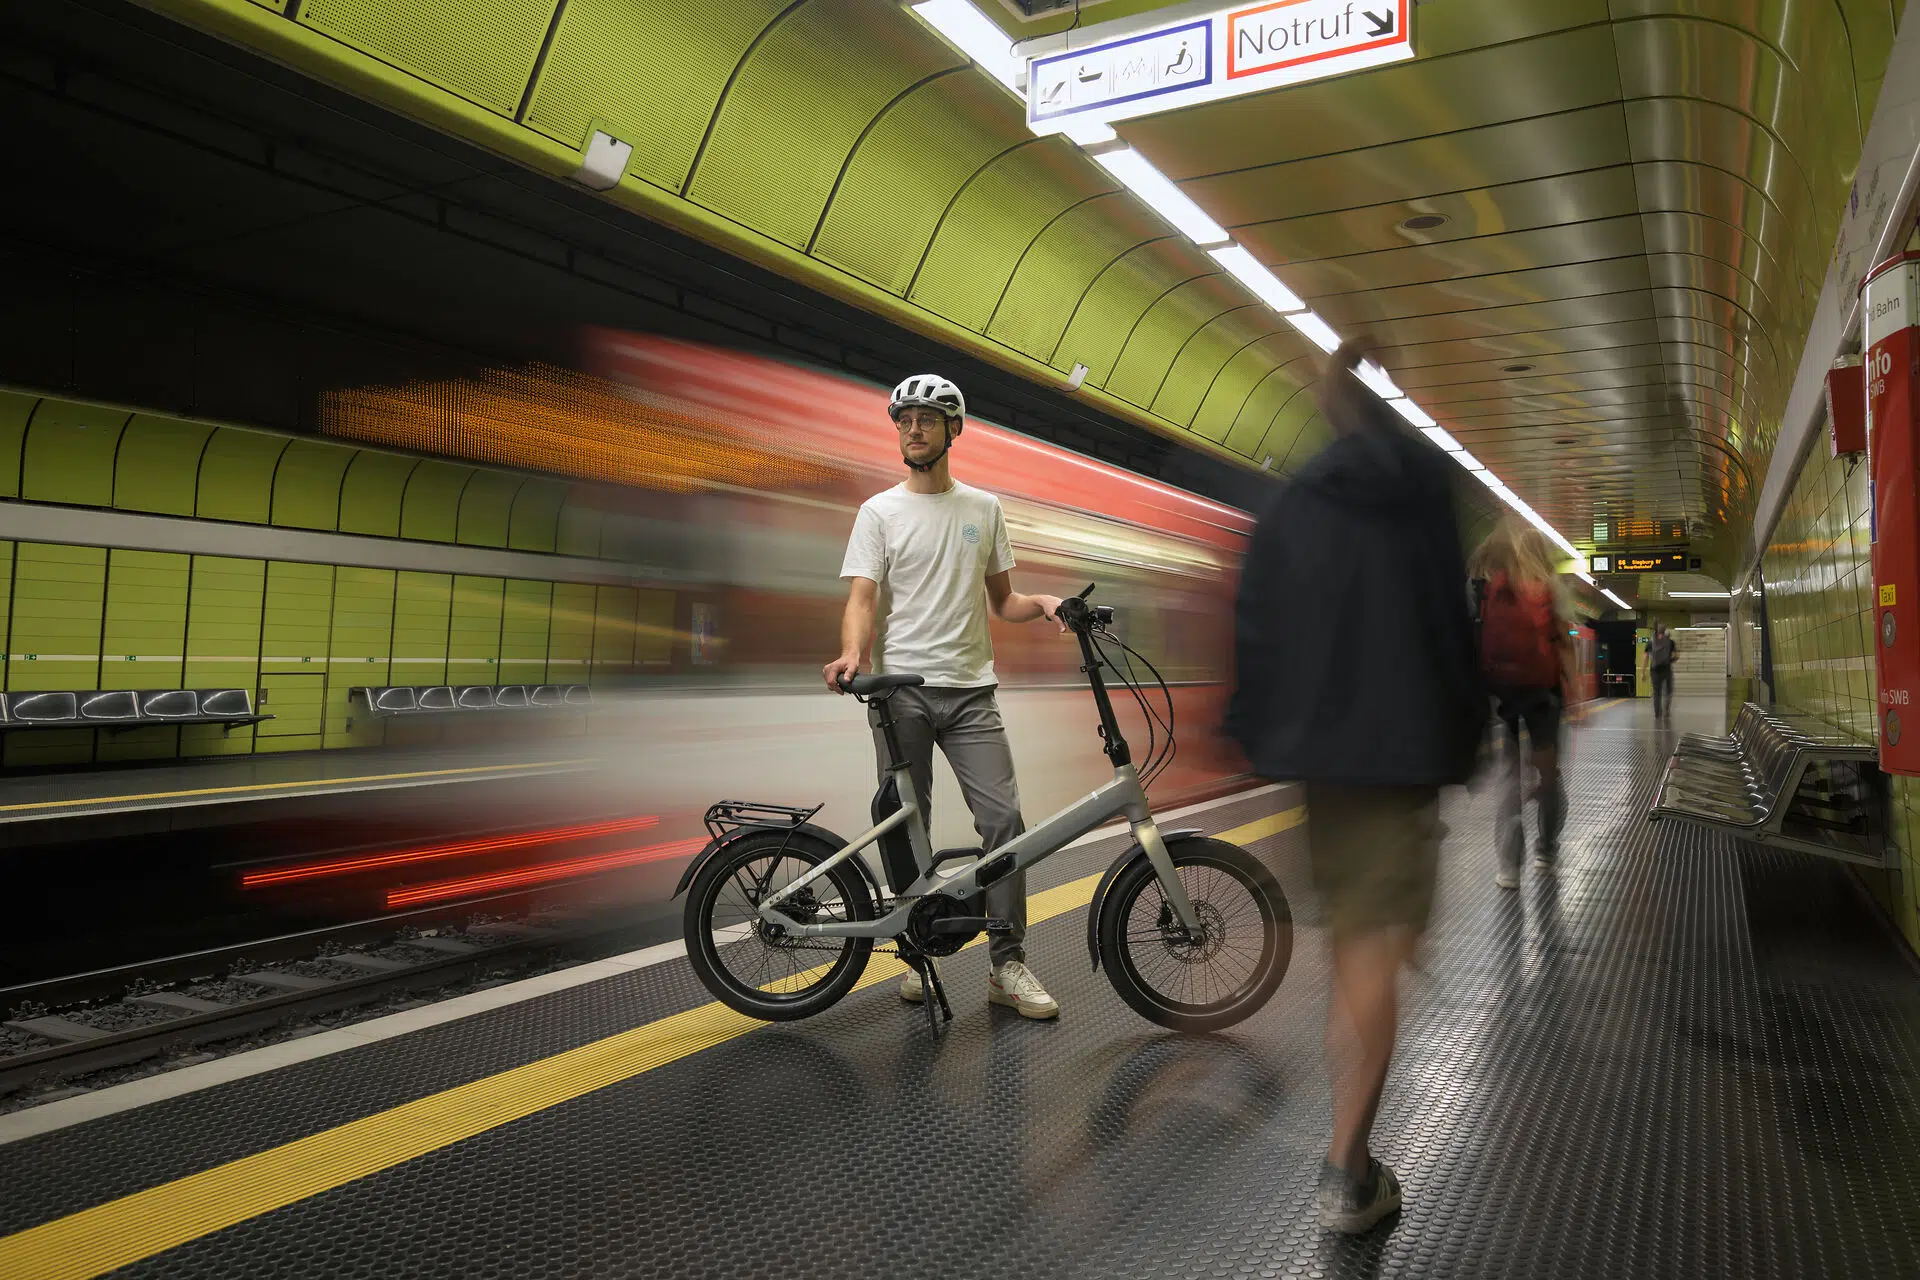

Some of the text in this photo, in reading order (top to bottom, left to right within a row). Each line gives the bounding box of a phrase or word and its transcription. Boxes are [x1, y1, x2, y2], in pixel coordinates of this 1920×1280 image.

[1238, 3, 1354, 59] Notruf
[1876, 296, 1900, 318] Bahn
[1869, 347, 1891, 382] nfo
[1880, 587, 1894, 603] Taxi
[1889, 689, 1909, 705] SWB
